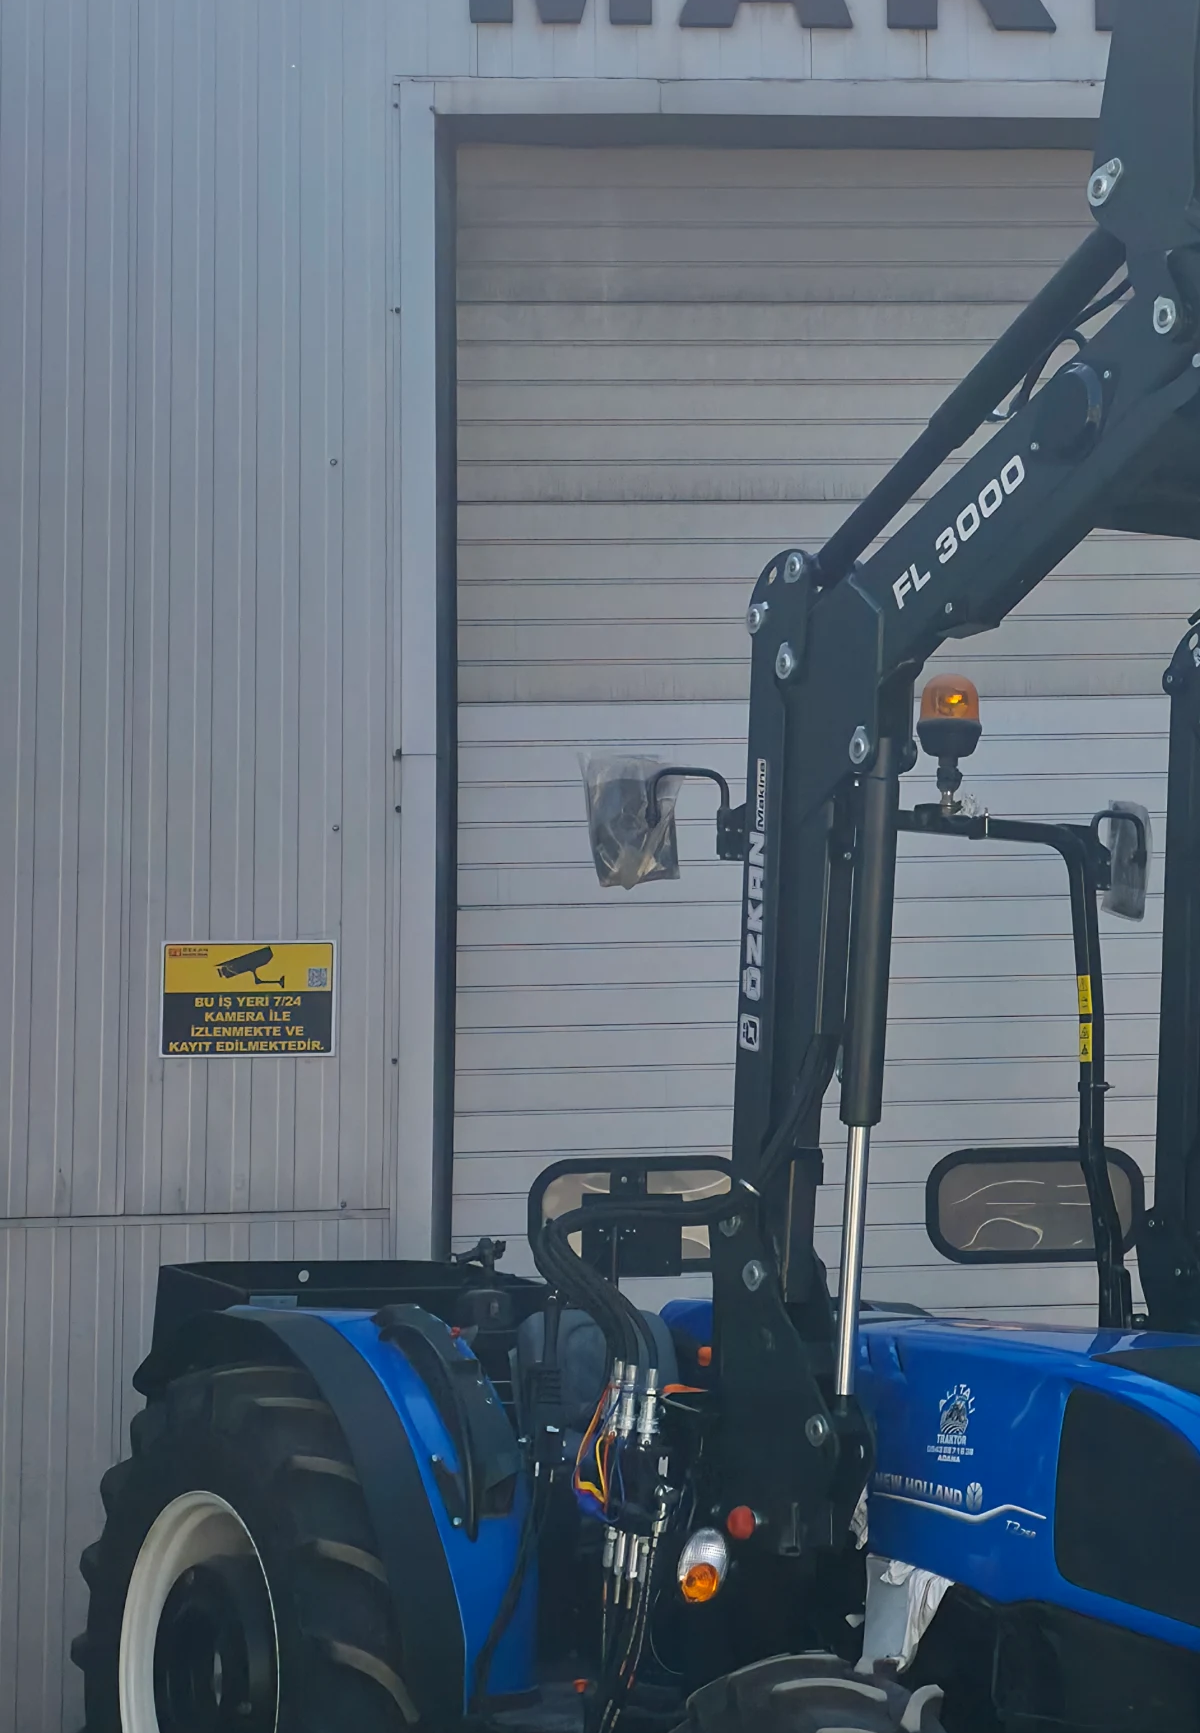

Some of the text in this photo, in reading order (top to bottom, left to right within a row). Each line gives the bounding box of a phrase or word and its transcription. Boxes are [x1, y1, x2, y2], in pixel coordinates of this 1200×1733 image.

[892, 454, 1025, 609] FL 3000
[742, 831, 765, 1002] ÖZKAN
[194, 995, 302, 1010] BU İŞ YERİ 7/24
[204, 1009, 291, 1022] KAMERA İLE
[191, 1025, 304, 1037] İZLENMEKTE VE
[169, 1037, 325, 1053] KAYIT EDİLMEKTEDİR.
[874, 1471, 963, 1506] NEW HOLLAND
